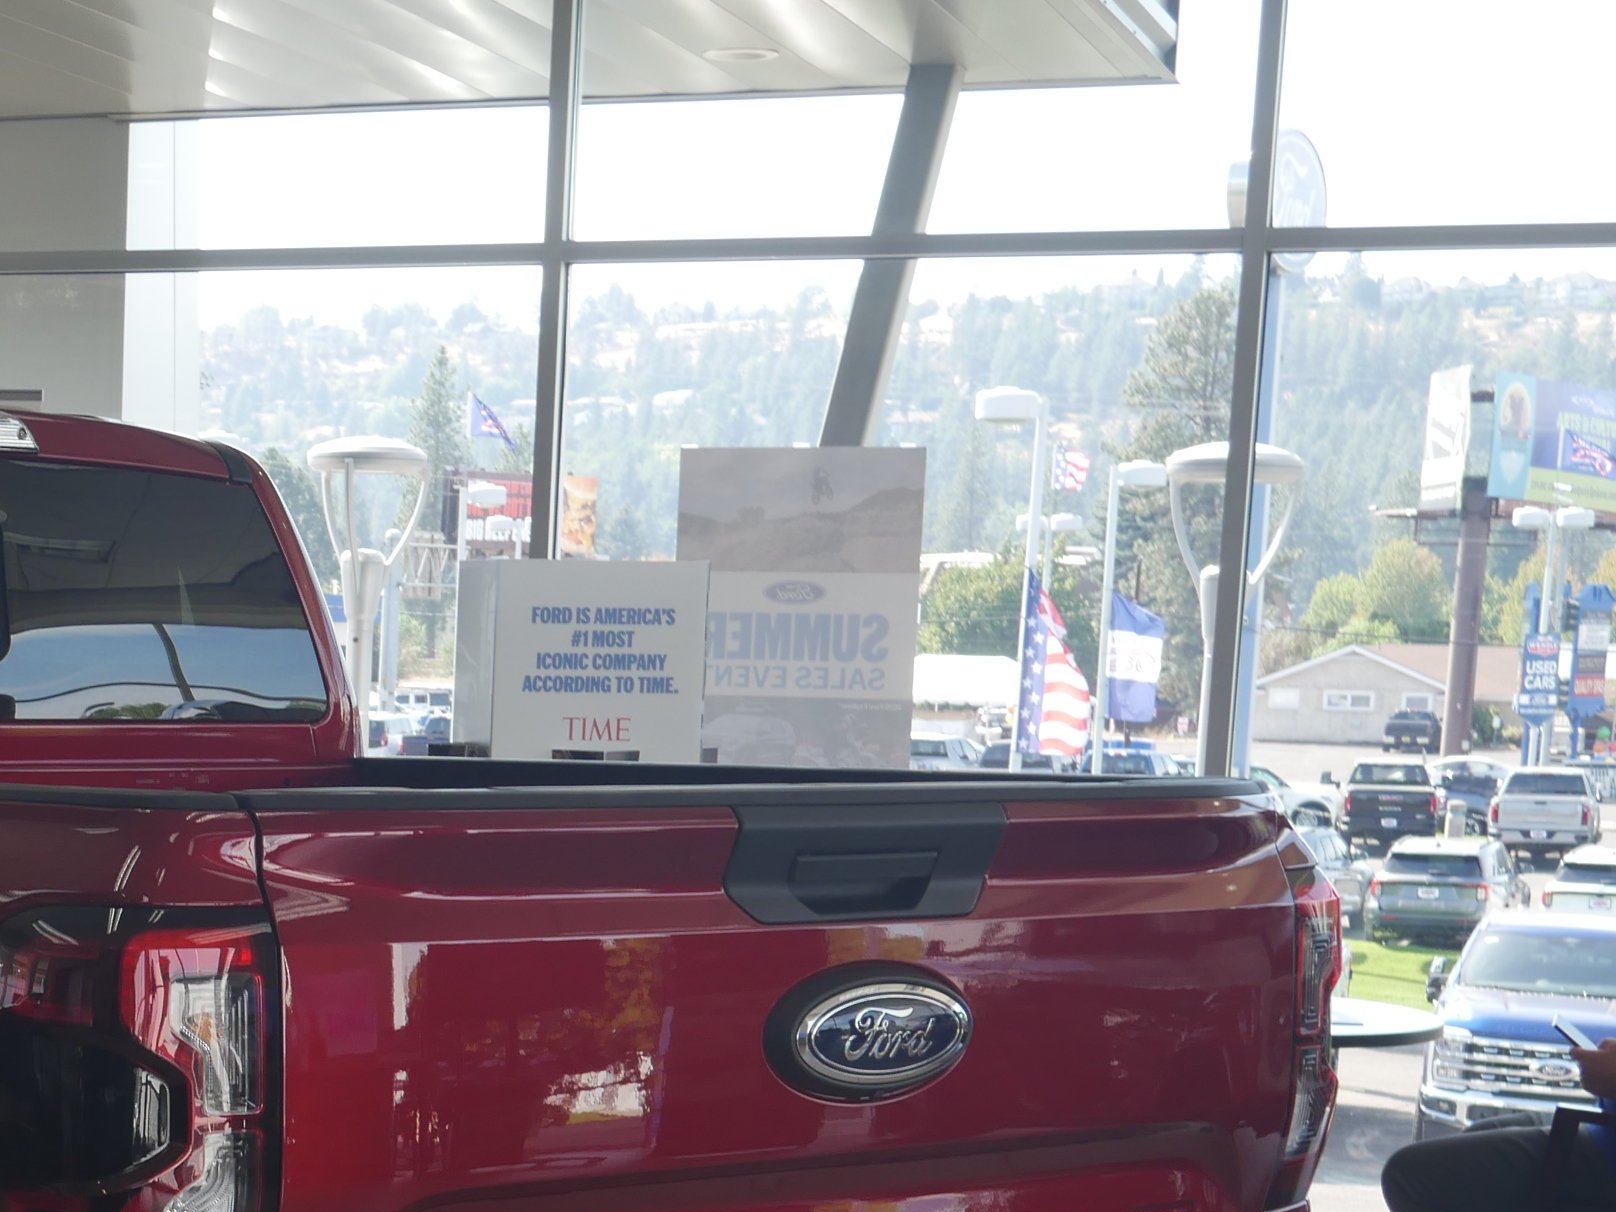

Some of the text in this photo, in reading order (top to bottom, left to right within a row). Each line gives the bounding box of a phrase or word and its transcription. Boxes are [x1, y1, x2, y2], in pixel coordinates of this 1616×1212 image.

[531, 606, 676, 625] FORD IS AMERICA'S
[571, 630, 635, 648] #1 MOST
[536, 652, 667, 671] ICONIC COMPANY
[1526, 660, 1557, 675] USED
[522, 675, 679, 694] ACCORDING TO TIME.
[1524, 676, 1556, 690] CARS
[562, 716, 631, 742] TIME
[841, 1006, 936, 1061] Ford
